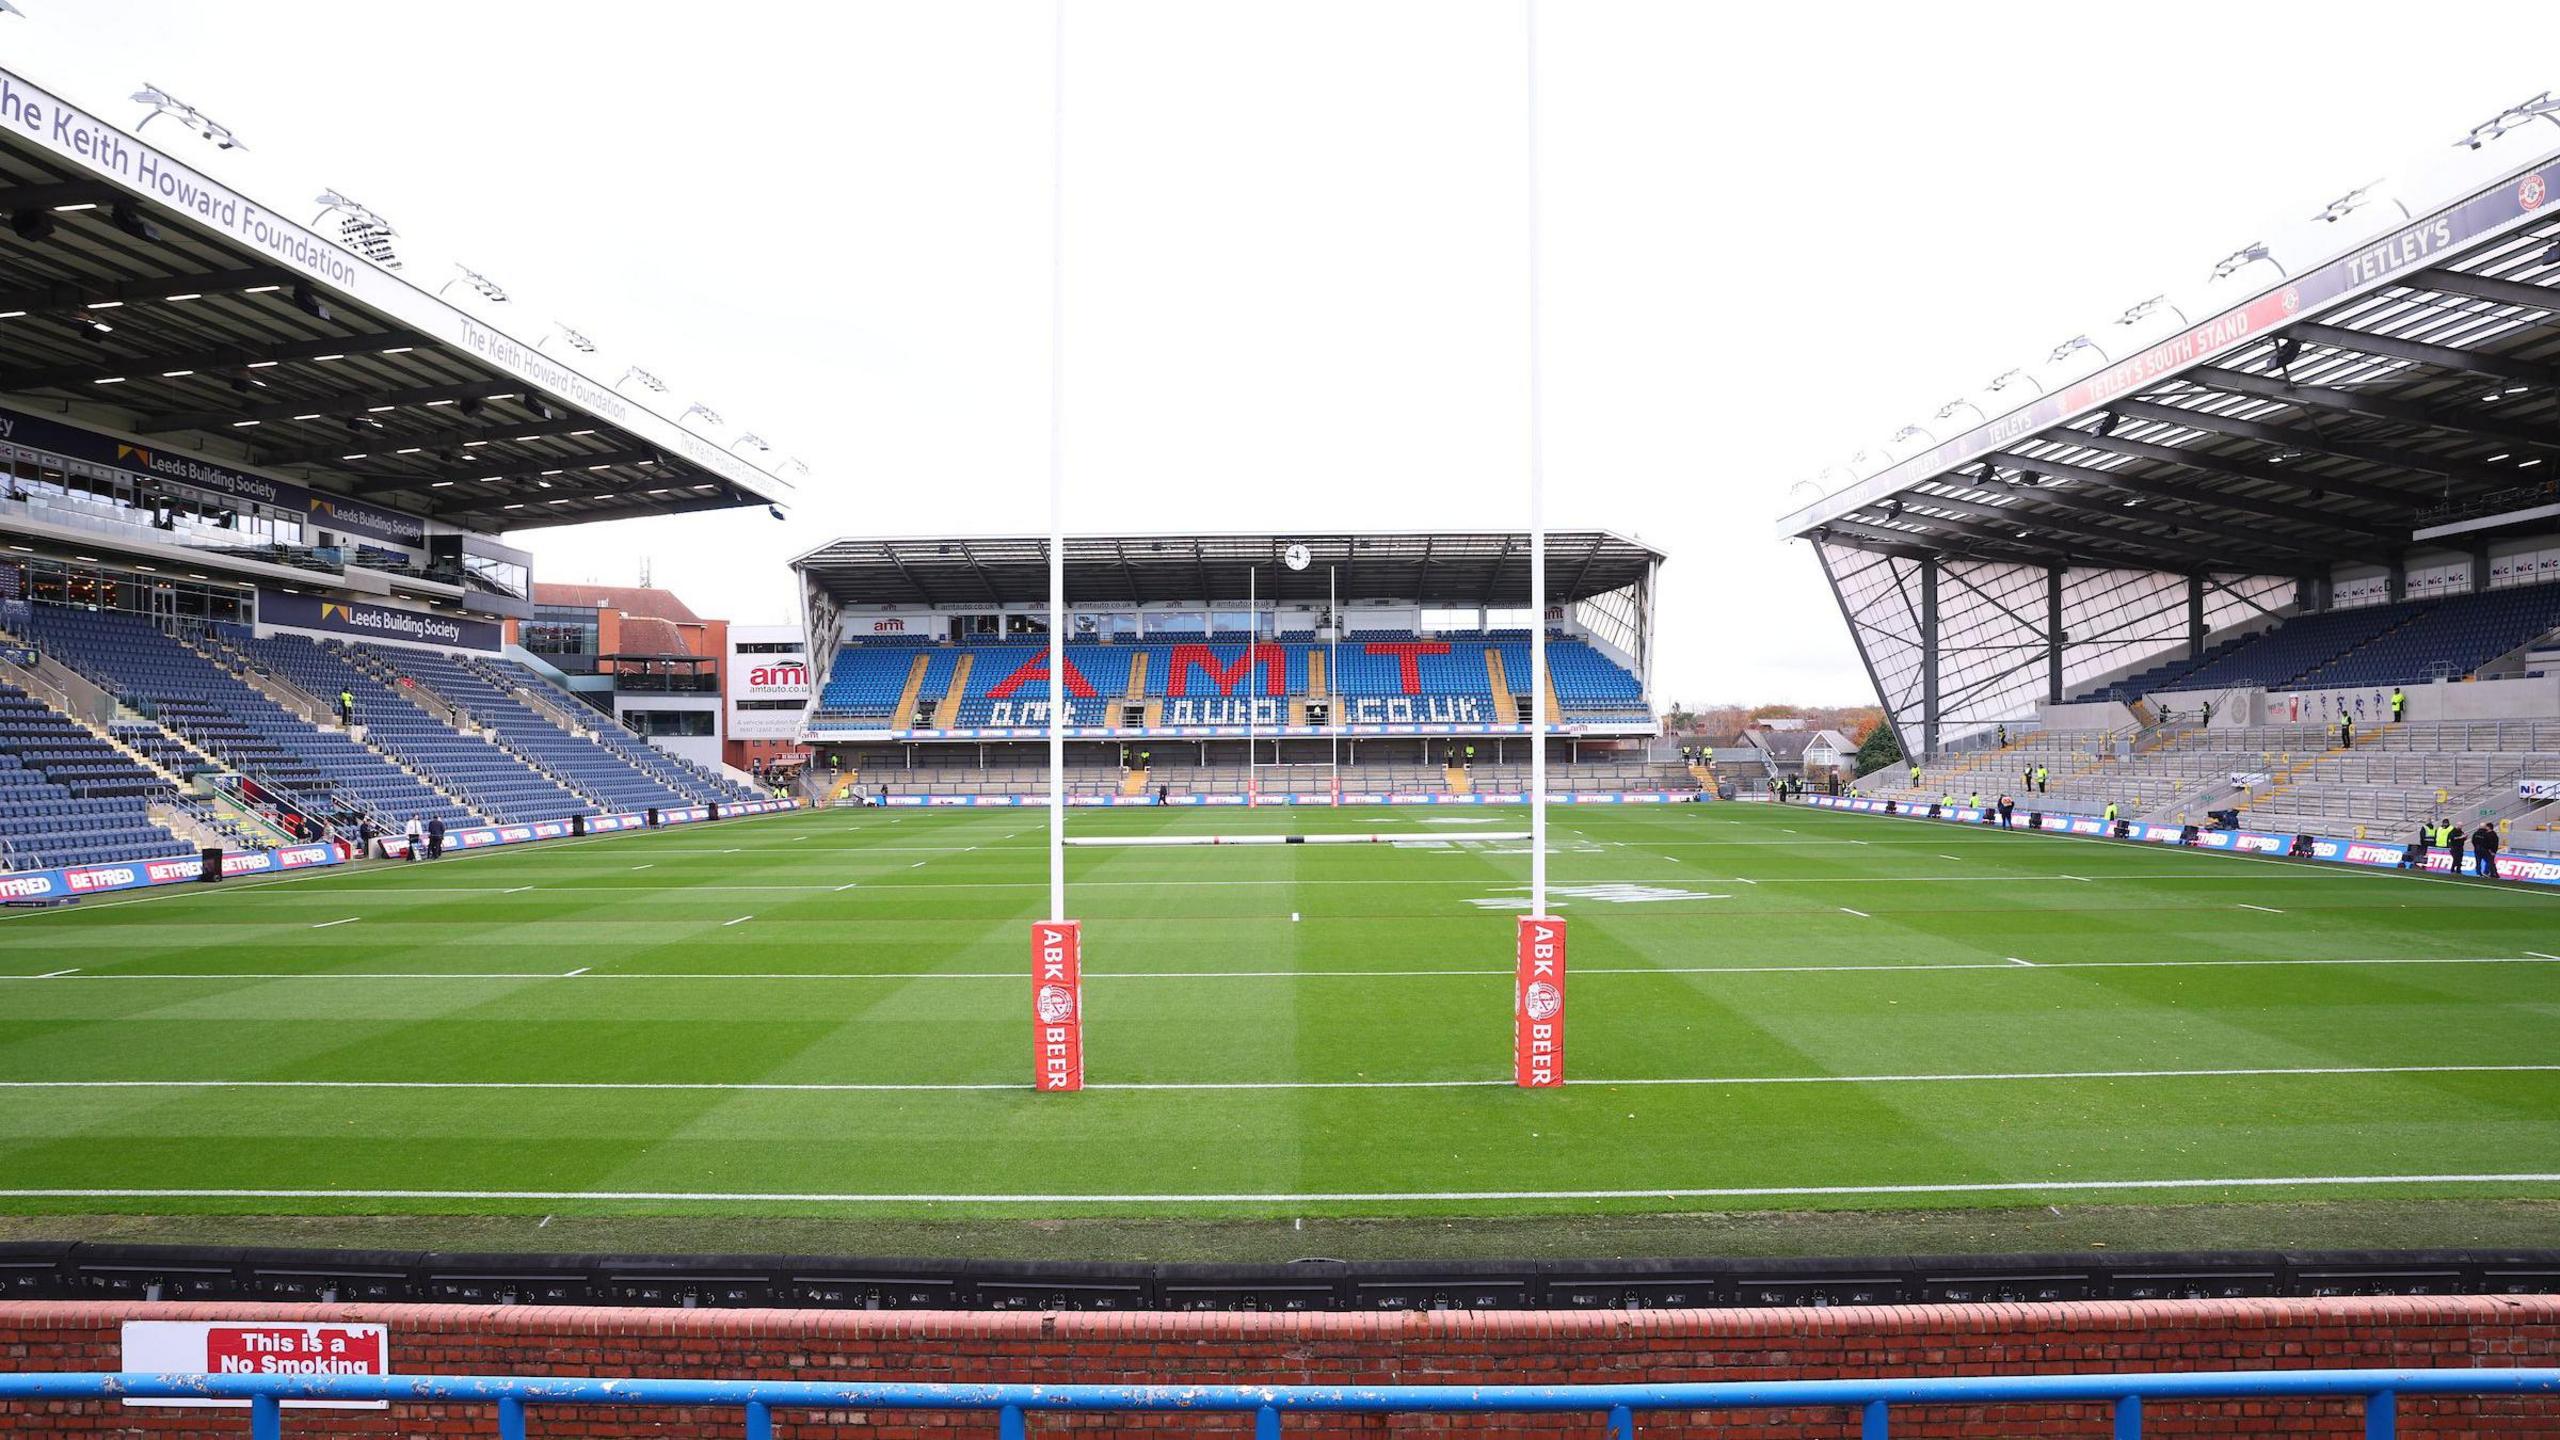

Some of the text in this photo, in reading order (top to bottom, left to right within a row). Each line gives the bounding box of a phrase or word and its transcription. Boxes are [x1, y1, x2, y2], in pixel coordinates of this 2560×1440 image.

[52, 106, 128, 175] Keith
[138, 152, 235, 228] Howard
[242, 205, 356, 289] Foundation
[2348, 218, 2450, 285] TETLEY'S
[2147, 338, 2193, 375] SOUTH
[2197, 313, 2248, 349] STAND
[461, 319, 627, 422] The Keith Howard Foundation
[149, 452, 277, 502] Leeds Building Society
[332, 504, 422, 542] Leeds Building Society
[349, 607, 460, 642] Leeds Building Society
[874, 618, 905, 631] amt
[749, 685, 807, 693] amtauto.co.u
[750, 664, 808, 686] amt
[281, 848, 327, 865] BETFRED
[2348, 845, 2402, 864] BETFRED
[0, 877, 51, 896] TFRED
[70, 869, 134, 888] BETFRED
[1043, 929, 1064, 980] ABK
[1534, 925, 1554, 977] ABK
[1045, 1027, 1068, 1090] BEER
[1532, 1023, 1553, 1086] BEER
[241, 1333, 345, 1352] This is a
[220, 1355, 368, 1375] No Smoking
